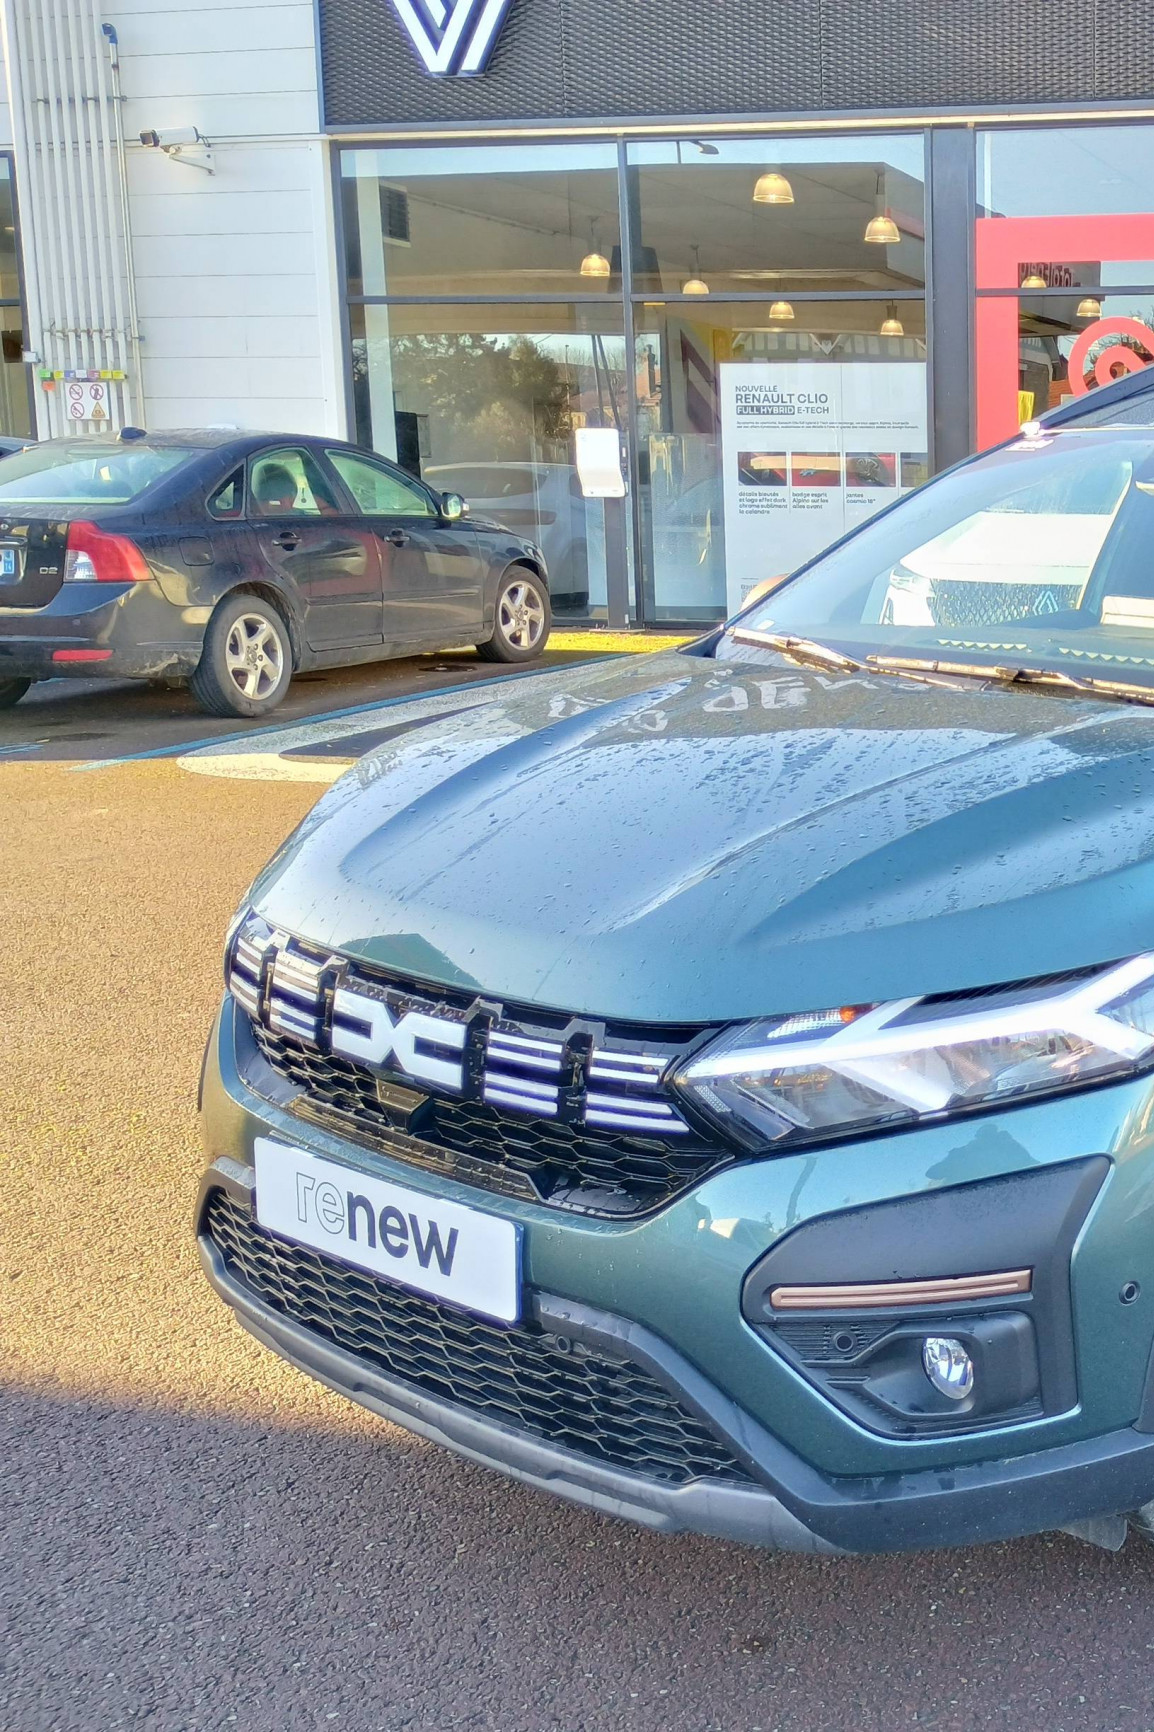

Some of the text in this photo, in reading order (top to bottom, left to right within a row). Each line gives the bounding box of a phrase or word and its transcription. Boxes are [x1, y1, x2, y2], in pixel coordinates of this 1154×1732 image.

[735, 385, 778, 393] NOUVELLE
[735, 393, 829, 404] RENAULT CLIO
[737, 406, 829, 414] FULL HYBRID E-TECH
[296, 1172, 459, 1277] renew
